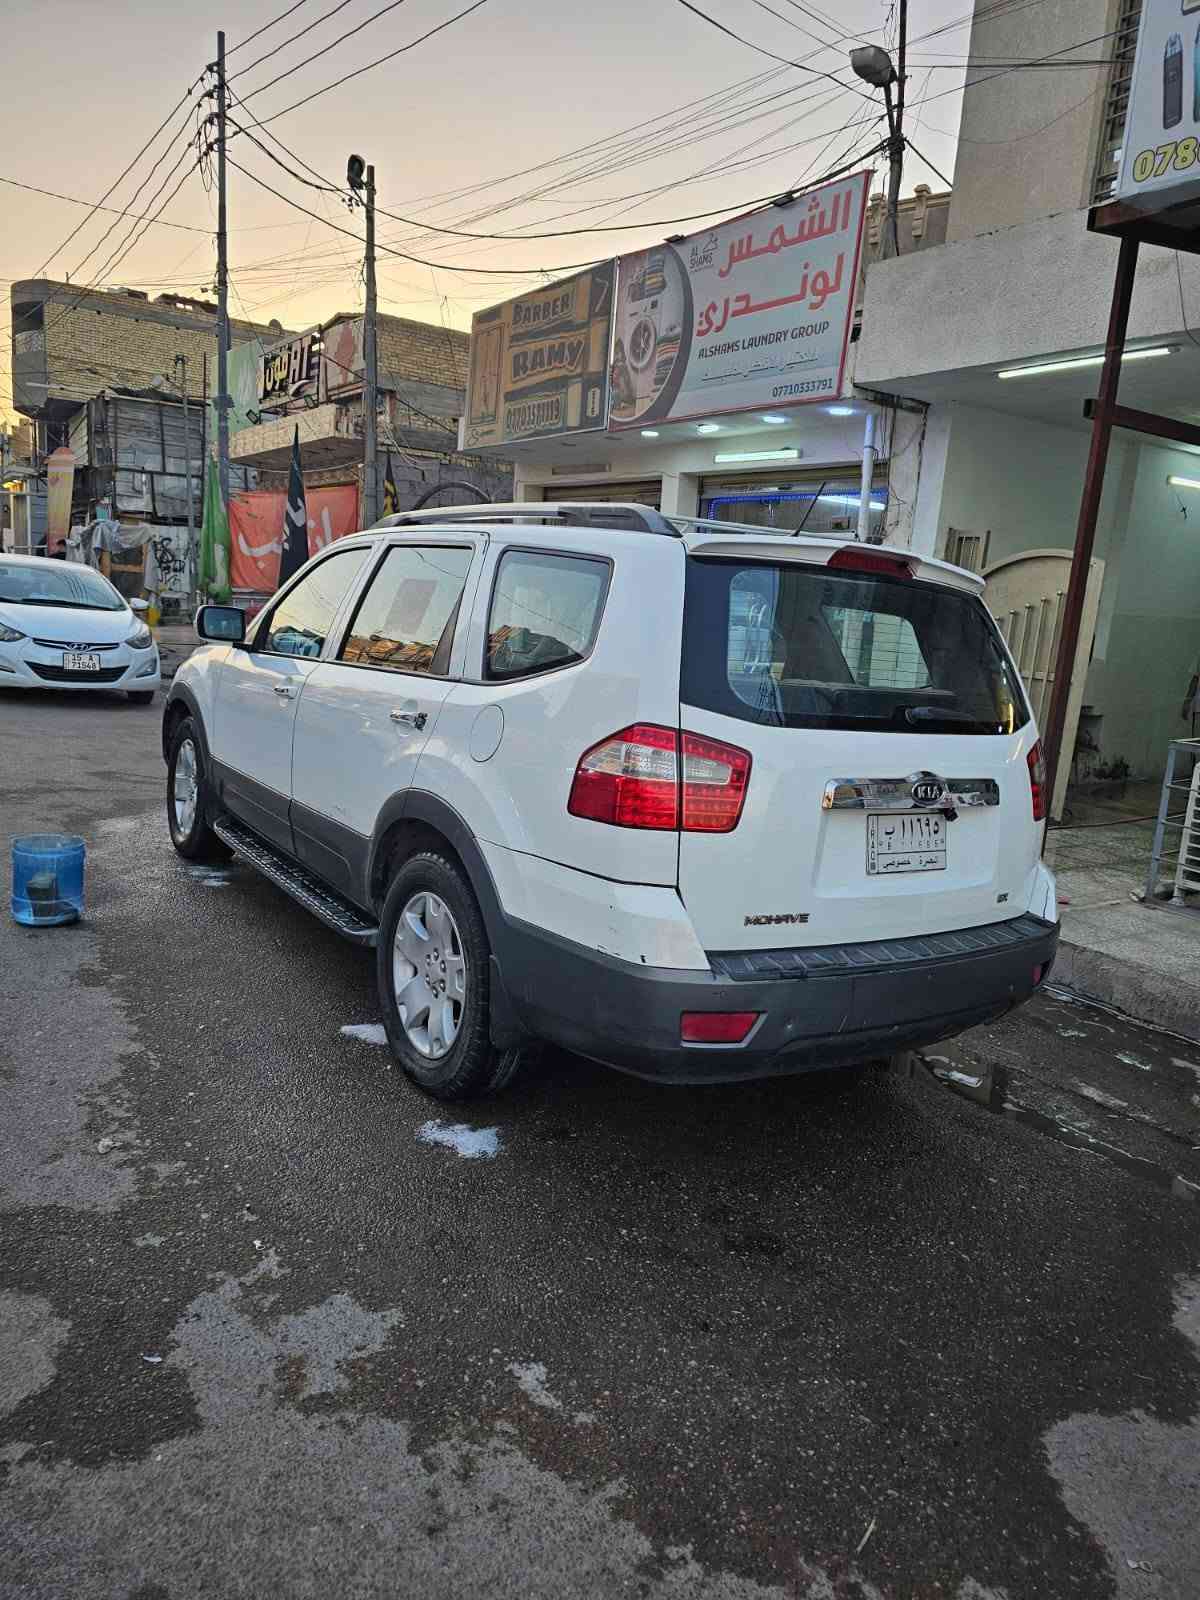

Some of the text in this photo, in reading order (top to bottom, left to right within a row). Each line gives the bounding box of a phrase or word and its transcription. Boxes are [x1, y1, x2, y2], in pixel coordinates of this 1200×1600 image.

[1133, 137, 1200, 183] 078
[719, 190, 852, 278] الشمس
[697, 321, 830, 360] ALSHAMS LAUNDRY GROUP
[512, 338, 584, 381] RAMY
[772, 378, 833, 398] 07710333791
[917, 786, 940, 799] KIA
[902, 817, 940, 838] ١١٦٩٥
[744, 913, 810, 926] MOHAVE
